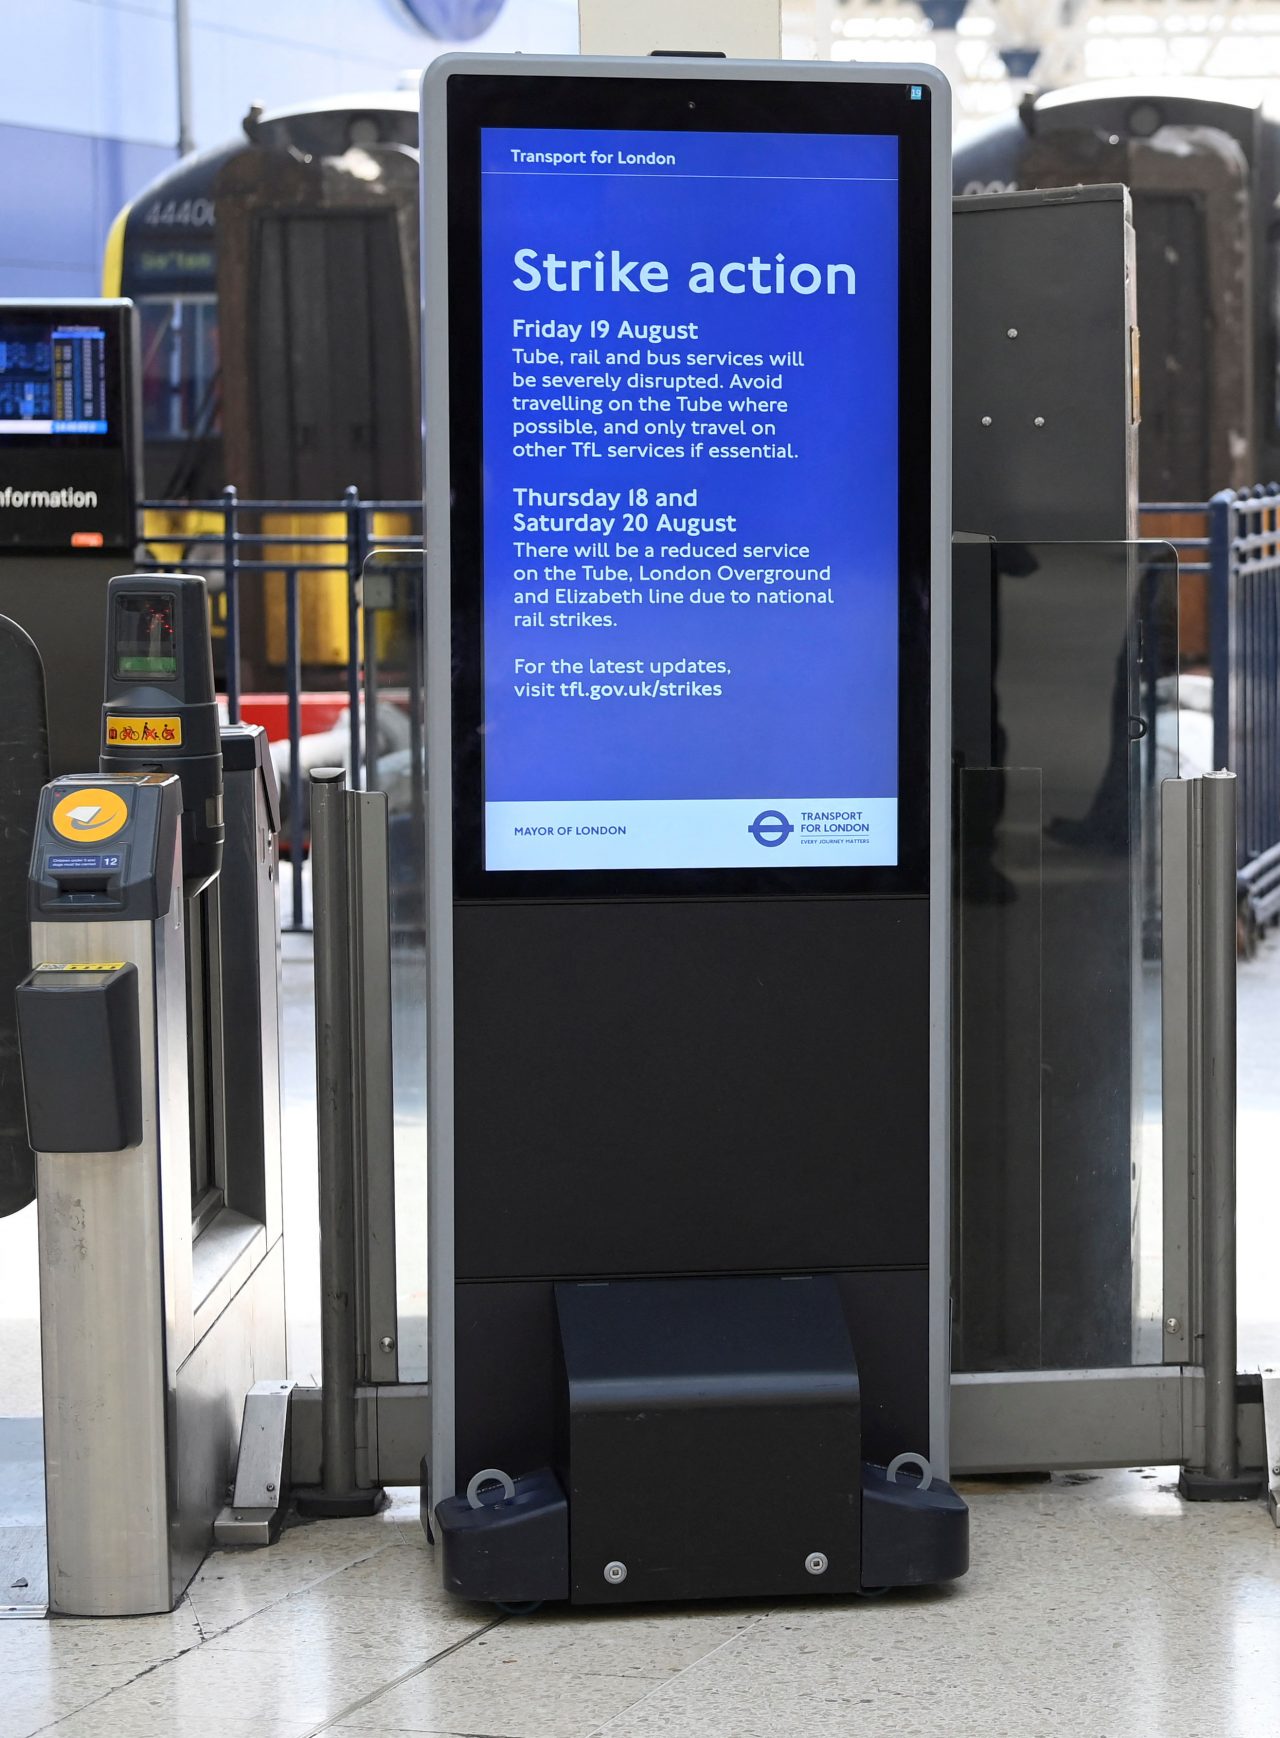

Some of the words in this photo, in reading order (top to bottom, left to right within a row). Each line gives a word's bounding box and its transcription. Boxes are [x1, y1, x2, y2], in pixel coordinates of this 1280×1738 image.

[510, 148, 587, 167] Transport
[589, 149, 614, 164] for
[617, 150, 676, 166] London
[512, 248, 669, 294] Strike
[688, 252, 856, 295] action
[512, 318, 583, 343] Friday
[590, 319, 610, 339] 19
[616, 320, 699, 344] August
[511, 347, 564, 367] Tube,
[570, 348, 601, 365] rail
[605, 349, 641, 366] and
[646, 349, 682, 366] bus
[686, 350, 764, 367] services
[768, 350, 805, 367] will
[512, 371, 537, 388] be
[541, 372, 622, 392] severely
[626, 372, 724, 393] disrupted.
[728, 373, 783, 390] Avoid
[511, 395, 604, 415] travelling
[608, 399, 633, 412] on
[637, 395, 671, 412] the
[675, 395, 723, 412] Tube
[727, 396, 788, 413] where
[512, 418, 598, 438] possible,
[603, 418, 639, 435] and
[644, 418, 687, 439] only
[690, 419, 747, 436] travel
[751, 423, 776, 436] on
[512, 441, 567, 458] other
[570, 441, 603, 458] TfL
[607, 442, 685, 458] services
[690, 442, 704, 458] if
[708, 442, 799, 459] essential.
[512, 487, 622, 512] Thursday
[628, 487, 649, 507] 18
[655, 488, 698, 507] and
[512, 512, 616, 537] Saturday
[622, 512, 649, 533] 20
[655, 513, 737, 537] August
[512, 541, 569, 558] There
[573, 542, 611, 558] will
[615, 542, 639, 558] be
[644, 545, 655, 558] a
[660, 542, 737, 558] reduced
[743, 543, 810, 558] service
[513, 568, 538, 581] on
[543, 565, 577, 581] the
[581, 565, 633, 583] Tube,
[639, 565, 712, 581] London
[717, 565, 831, 585] Overground
[513, 588, 549, 604] and
[555, 588, 643, 604] Elizabeth
[649, 588, 684, 604] line
[689, 588, 725, 604] due
[729, 589, 751, 604] to
[756, 588, 835, 604] national
[514, 611, 545, 627] rail
[549, 611, 618, 627] strikes.
[514, 658, 546, 675] For
[550, 658, 584, 674] the
[589, 658, 645, 674] latest
[649, 657, 731, 678] updates,
[513, 682, 555, 697] visit
[559, 679, 723, 701] tfl.gov.uk/strikes
[800, 811, 864, 821] TRANSPORT
[514, 825, 555, 837] MAYOR
[556, 825, 573, 837] OF
[575, 825, 627, 837] LONDON
[800, 823, 822, 833] FOR
[823, 823, 870, 833] LONDON
[103, 857, 118, 866] 12
